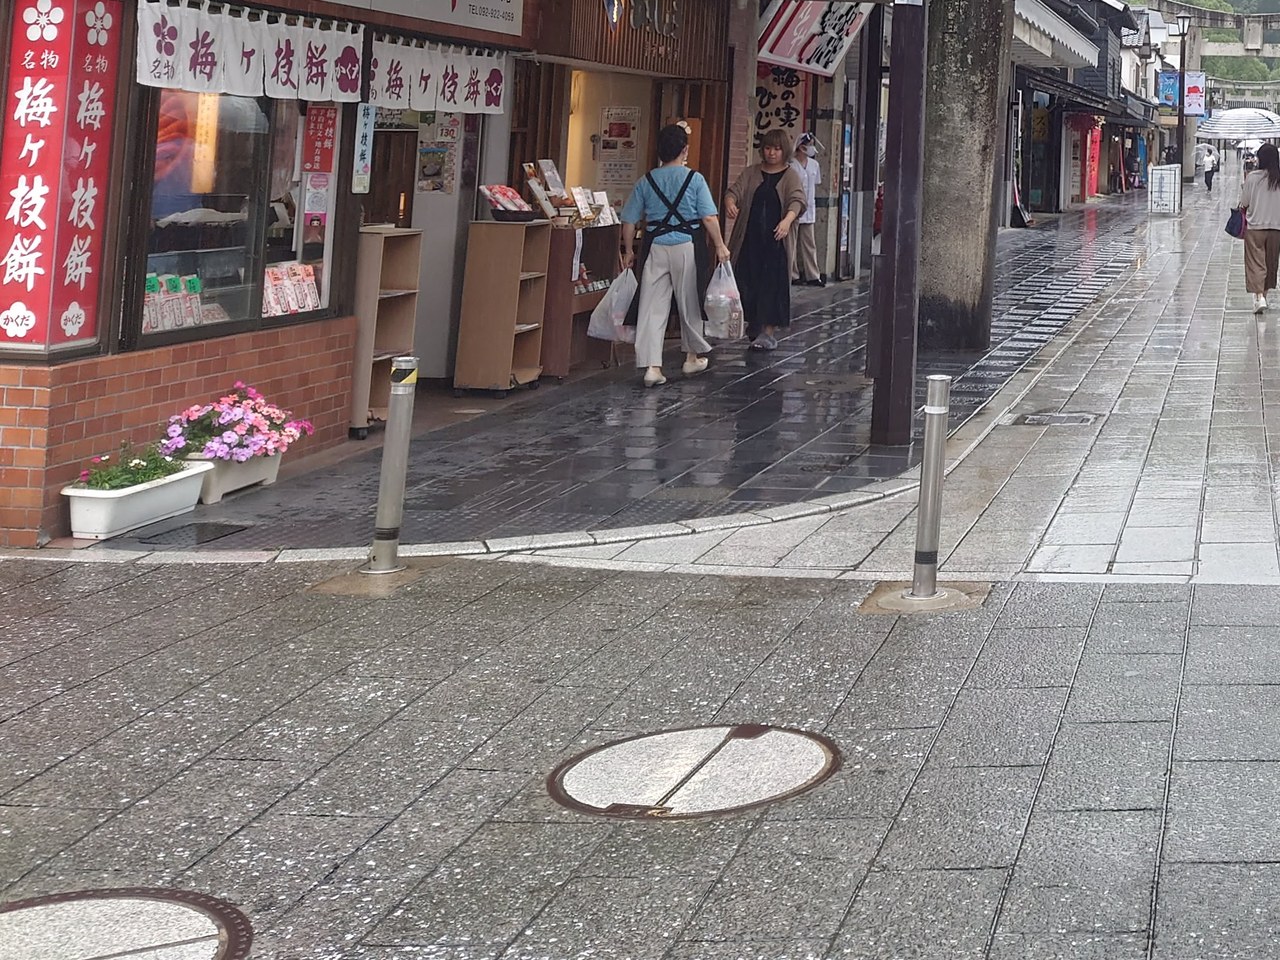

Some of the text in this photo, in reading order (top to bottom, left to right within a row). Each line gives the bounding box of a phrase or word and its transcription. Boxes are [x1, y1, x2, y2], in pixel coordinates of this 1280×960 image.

[21, 49, 59, 69] 名物
[83, 54, 108, 73] 名物
[150, 58, 175, 80] 名物
[771, 67, 800, 128] 梅の実
[3, 315, 31, 327] かくだ
[63, 313, 83, 326] かくだ
